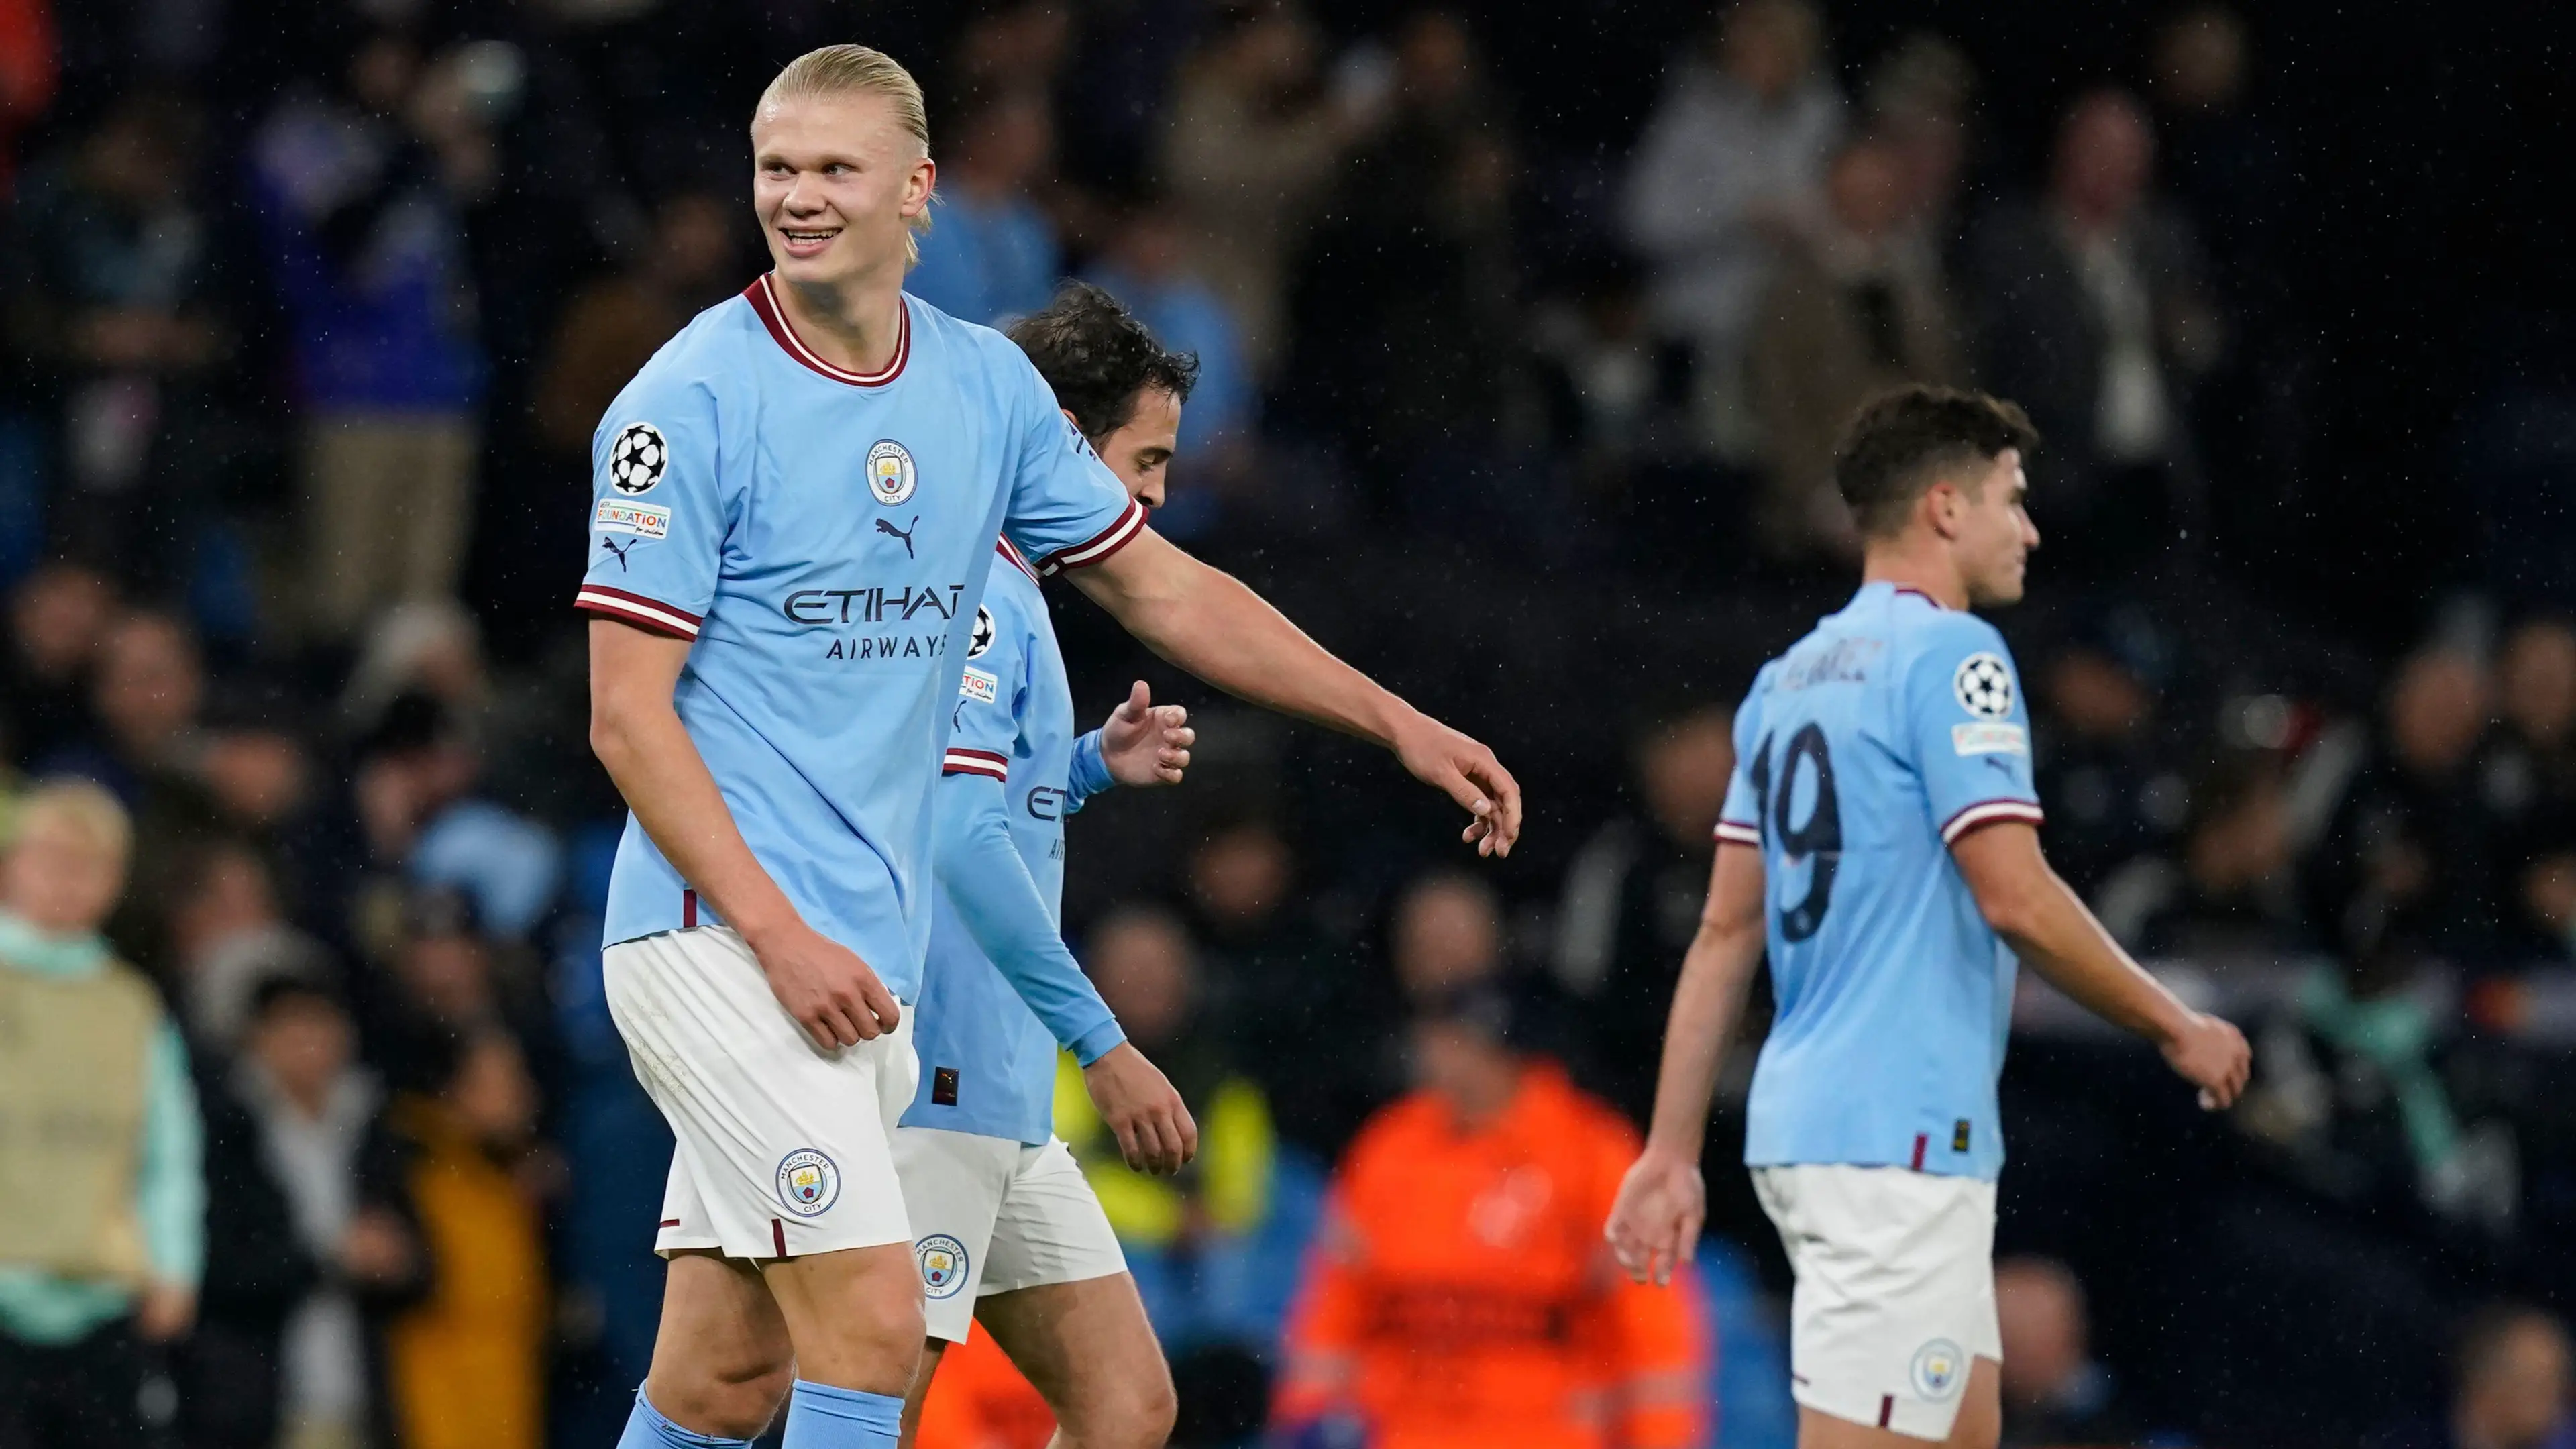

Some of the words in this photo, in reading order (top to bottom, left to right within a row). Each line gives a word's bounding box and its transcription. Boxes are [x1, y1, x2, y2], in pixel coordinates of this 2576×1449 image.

[869, 445, 909, 466] MANCHESTER
[962, 675, 994, 693] TION
[1750, 720, 1843, 942] 19
[781, 1154, 829, 1179] MANCHESTER
[804, 1203, 821, 1213] CITY
[916, 1239, 964, 1262] MANCHESTER
